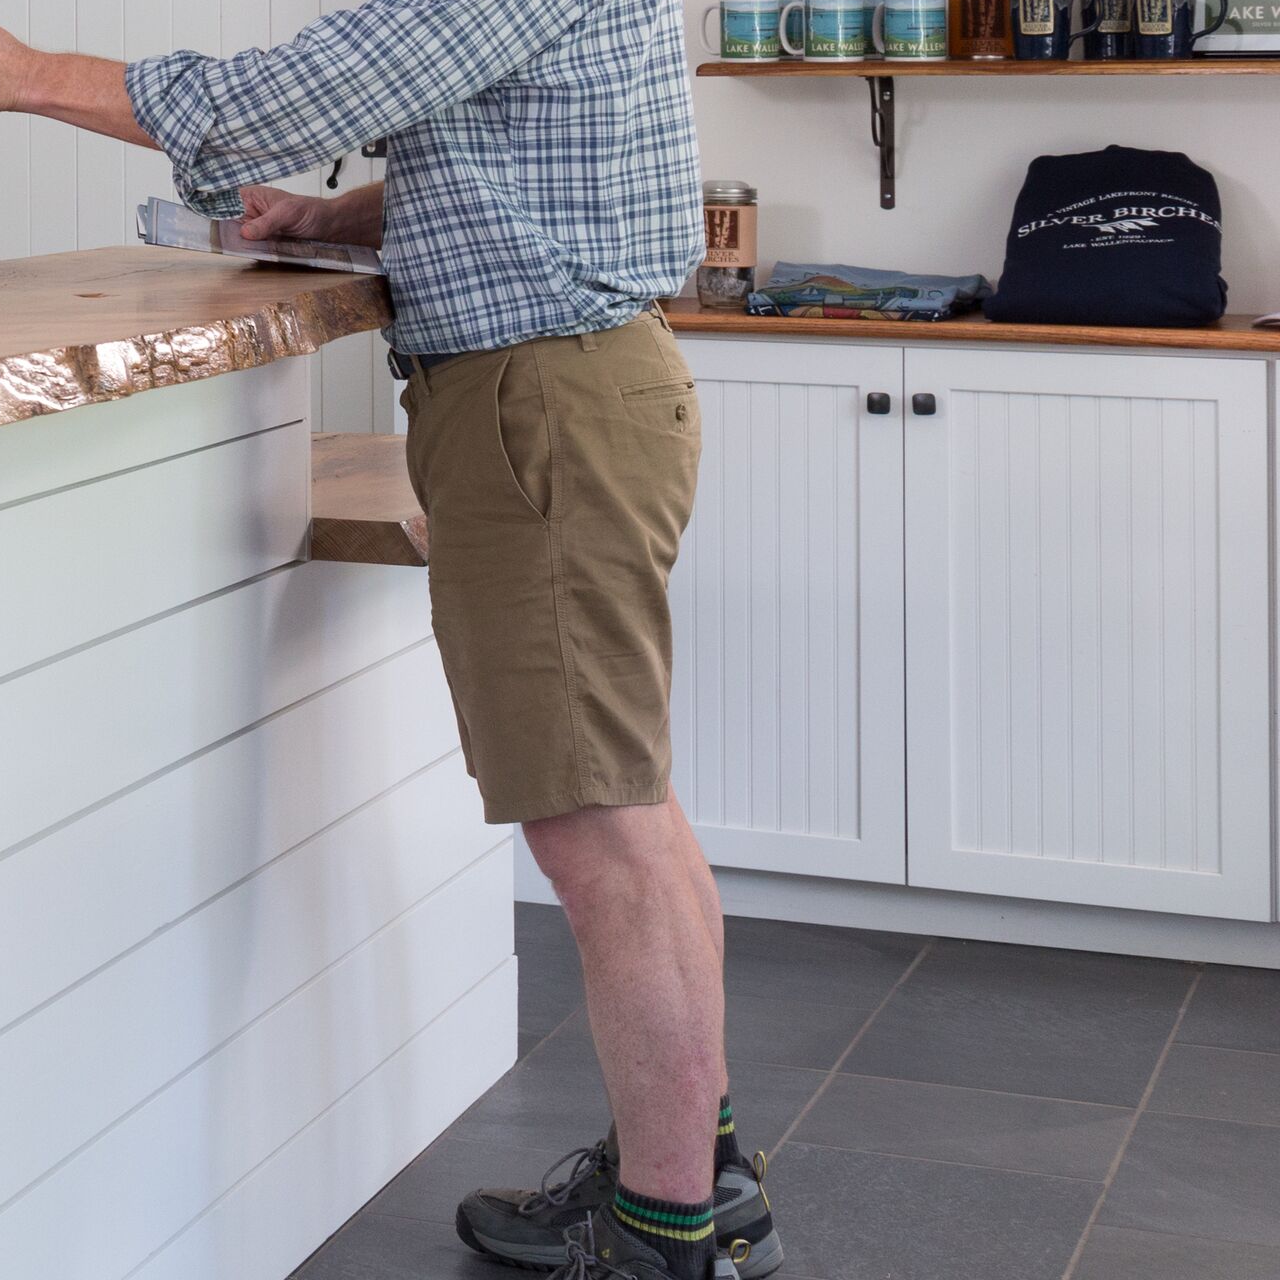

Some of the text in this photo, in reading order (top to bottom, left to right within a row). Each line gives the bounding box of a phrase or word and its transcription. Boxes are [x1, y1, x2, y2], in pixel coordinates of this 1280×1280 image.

[1226, 6, 1265, 19] AKE
[726, 44, 749, 53] LAKE
[811, 43, 835, 52] LAKE
[1055, 197, 1096, 213] VINTAGE
[1098, 191, 1158, 201] LAKEFRONT
[1017, 214, 1106, 237] SILVER
